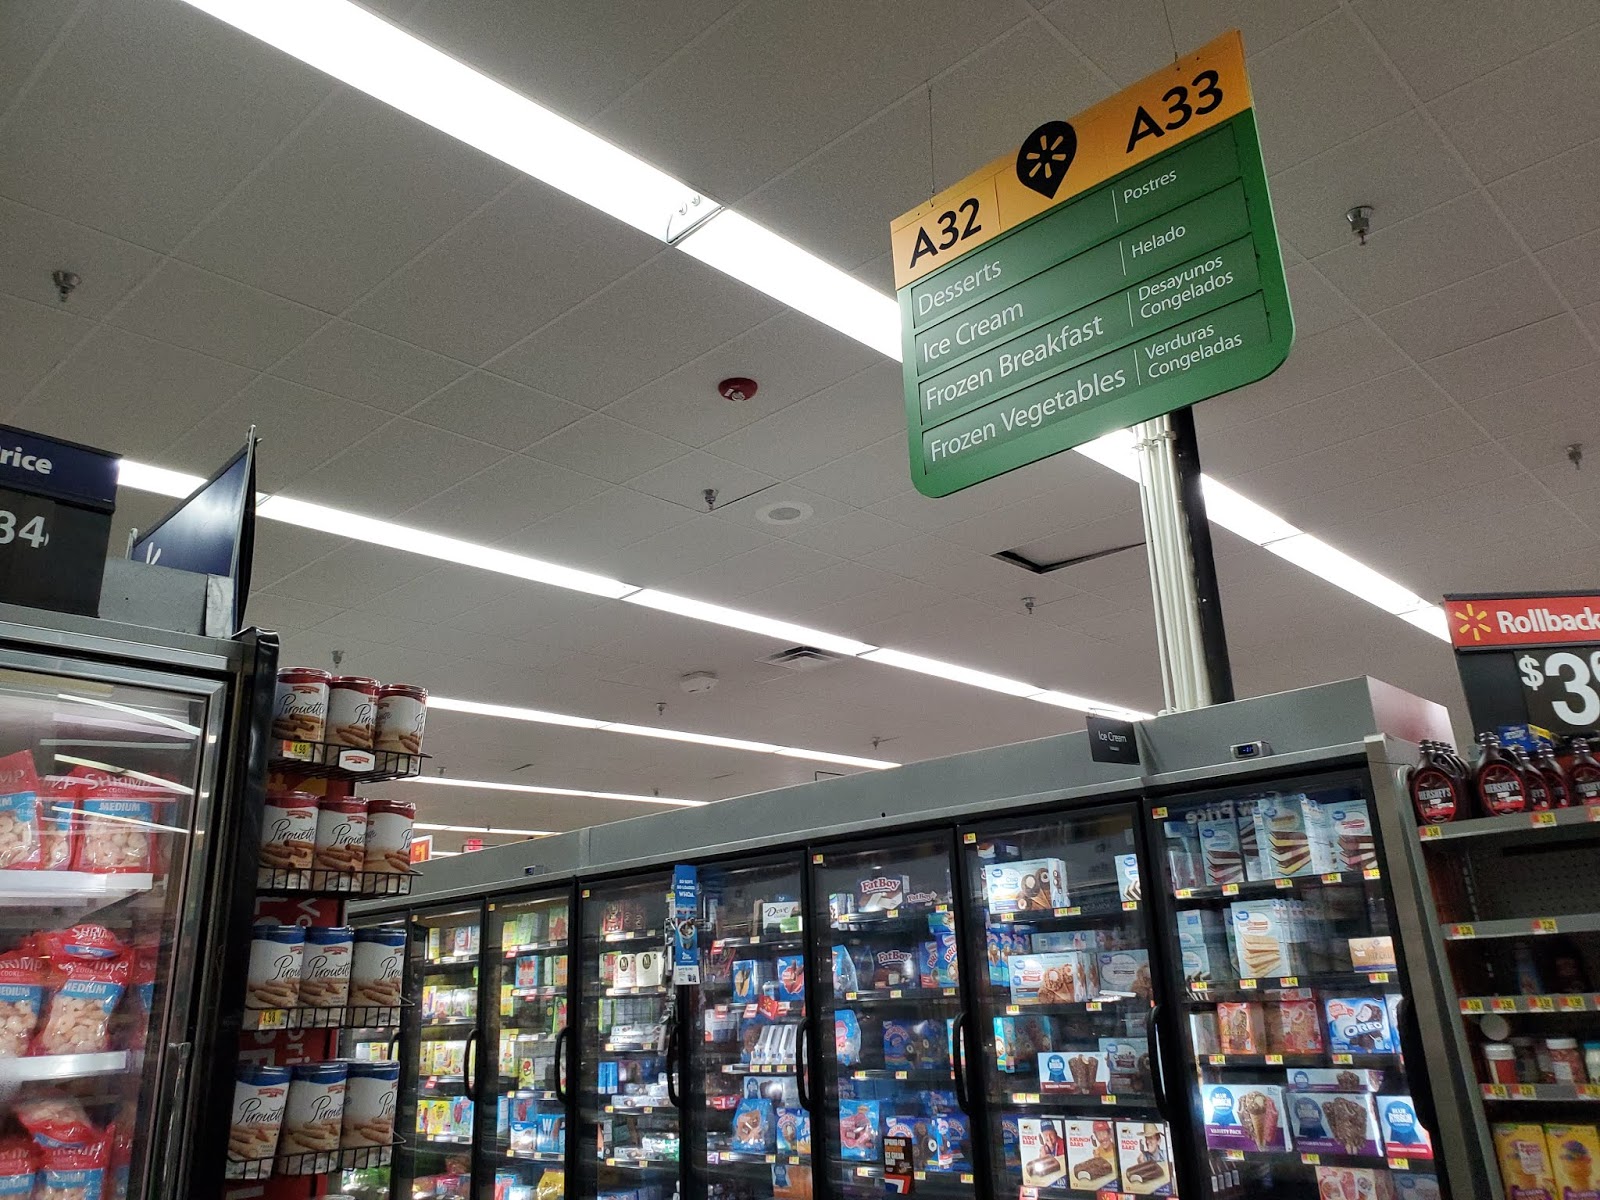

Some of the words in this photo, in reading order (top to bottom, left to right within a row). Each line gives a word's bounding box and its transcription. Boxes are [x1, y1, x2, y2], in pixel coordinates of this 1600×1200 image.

[1125, 69, 1224, 154] A33
[1123, 169, 1178, 203] Postres
[909, 197, 982, 270] A32
[1131, 223, 1187, 258] Helado
[918, 259, 1003, 317] Desserts
[1138, 255, 1223, 301] Desayunos
[1140, 271, 1235, 319] Congelados
[922, 341, 952, 364] Ice
[955, 303, 1025, 346] Cream
[1145, 321, 1216, 360] Verduras
[925, 370, 993, 411] Frozen
[999, 314, 1104, 378] Breakfast
[1147, 333, 1243, 380] Congeladas
[930, 422, 997, 463] Frozen
[1001, 368, 1127, 434] Vegetables
[0, 446, 52, 475] rice
[1496, 606, 1600, 634] Rollback
[1098, 730, 1107, 741] Ice
[1108, 731, 1127, 743] Cream
[99, 802, 140, 812] MEDIUM
[0, 985, 30, 996] EDIUM
[1344, 1020, 1383, 1038] OREO
